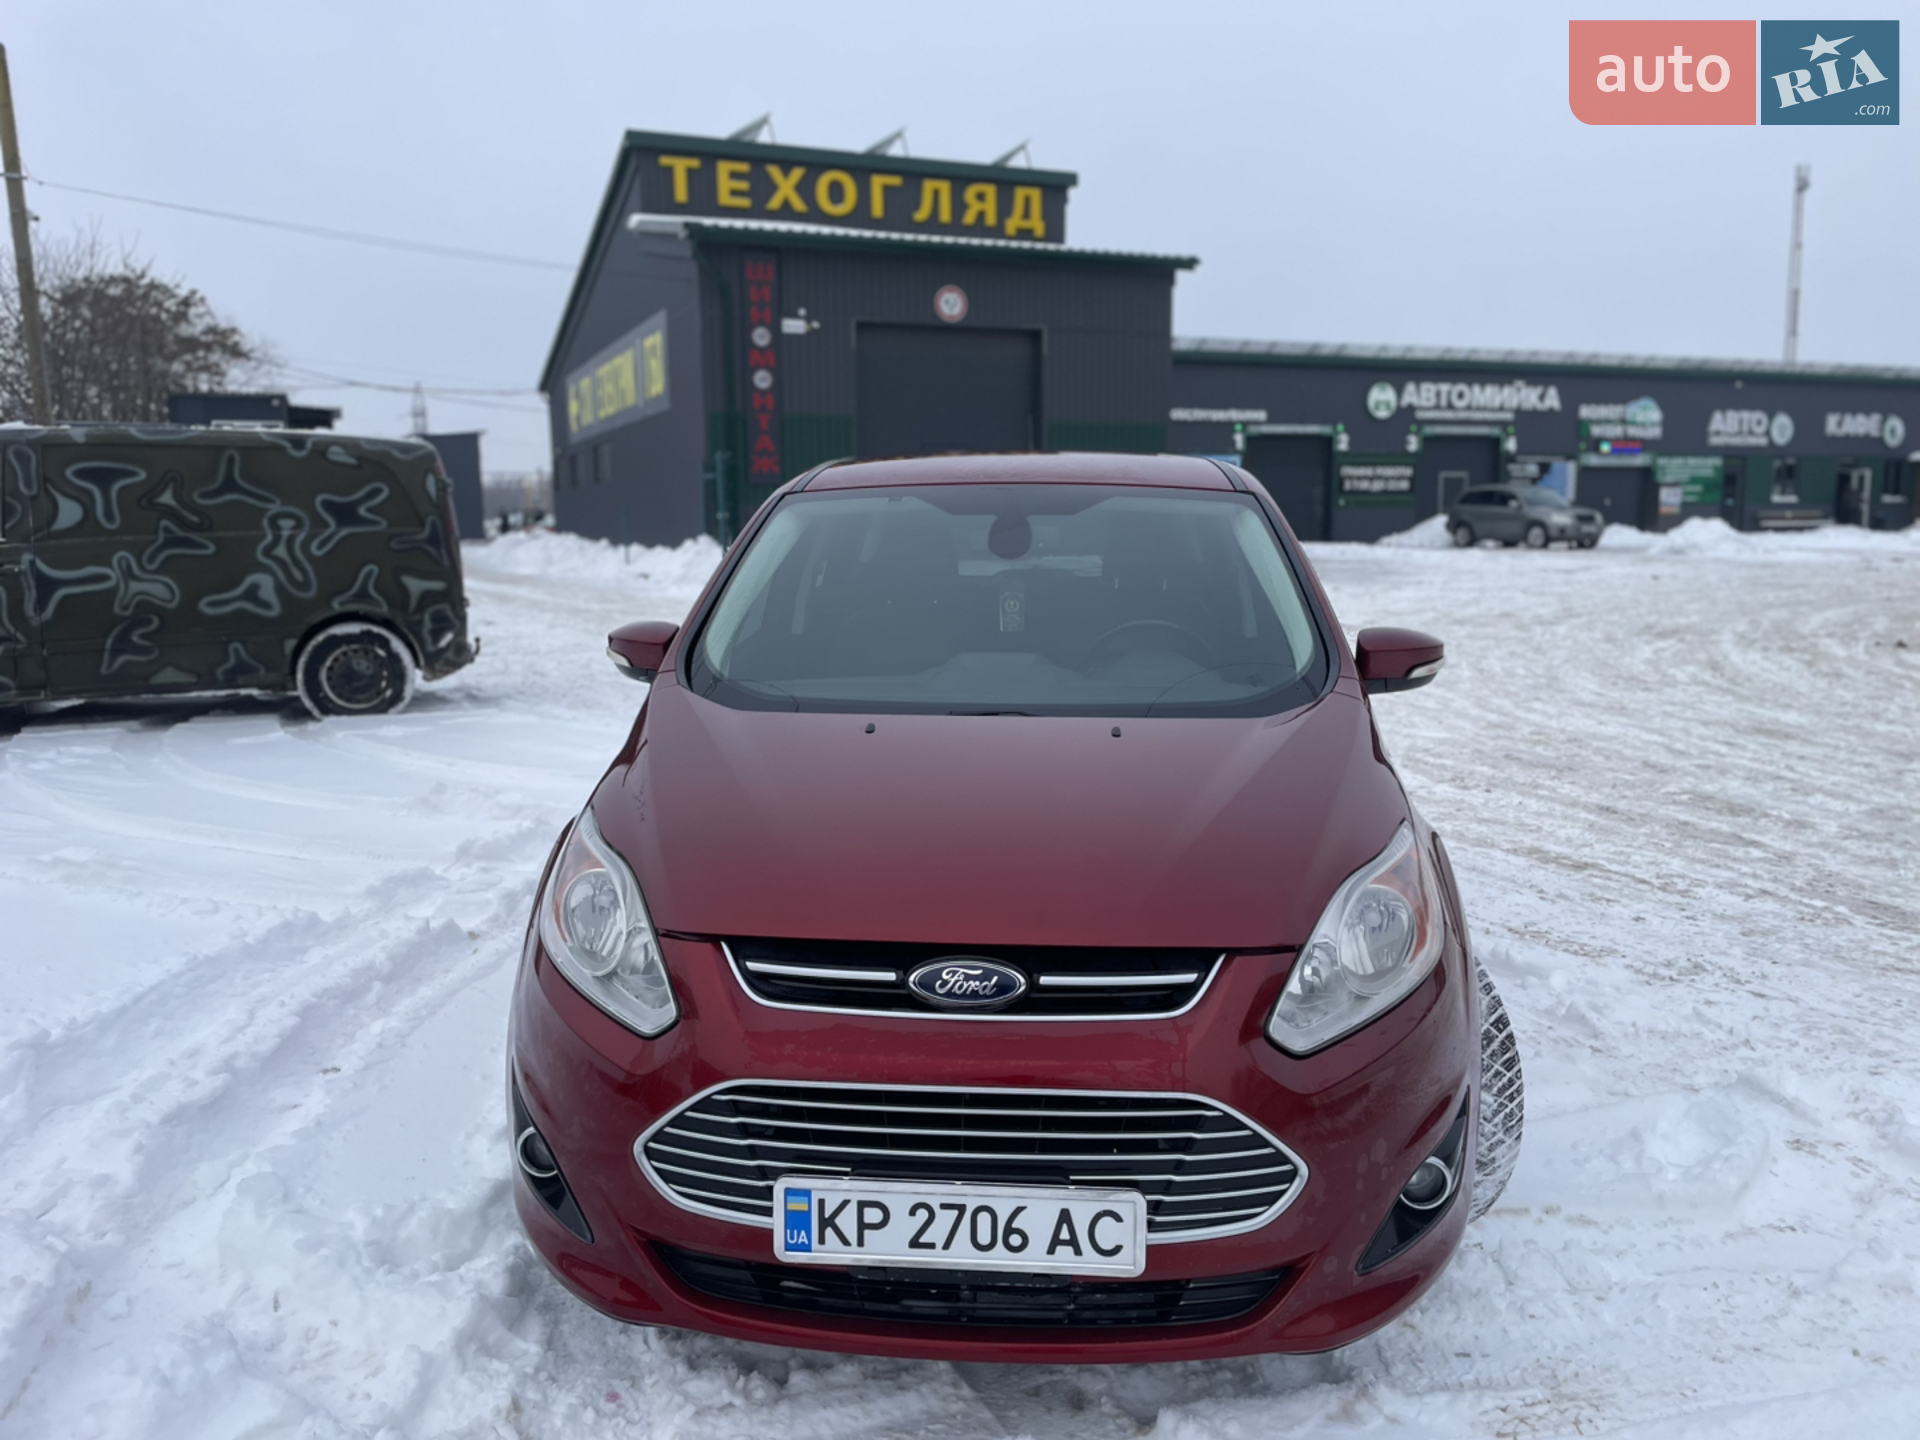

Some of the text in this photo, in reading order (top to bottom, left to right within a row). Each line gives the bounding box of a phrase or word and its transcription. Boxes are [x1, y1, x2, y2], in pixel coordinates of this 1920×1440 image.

[658, 155, 1046, 239] ТЕХОГЛЯД
[1400, 379, 1562, 412] АВТОМИЙКА
[1707, 410, 1769, 435] АВТО
[935, 967, 998, 996] Ford
[787, 1229, 809, 1245] UA
[817, 1198, 1125, 1258] KP 2706 AC
